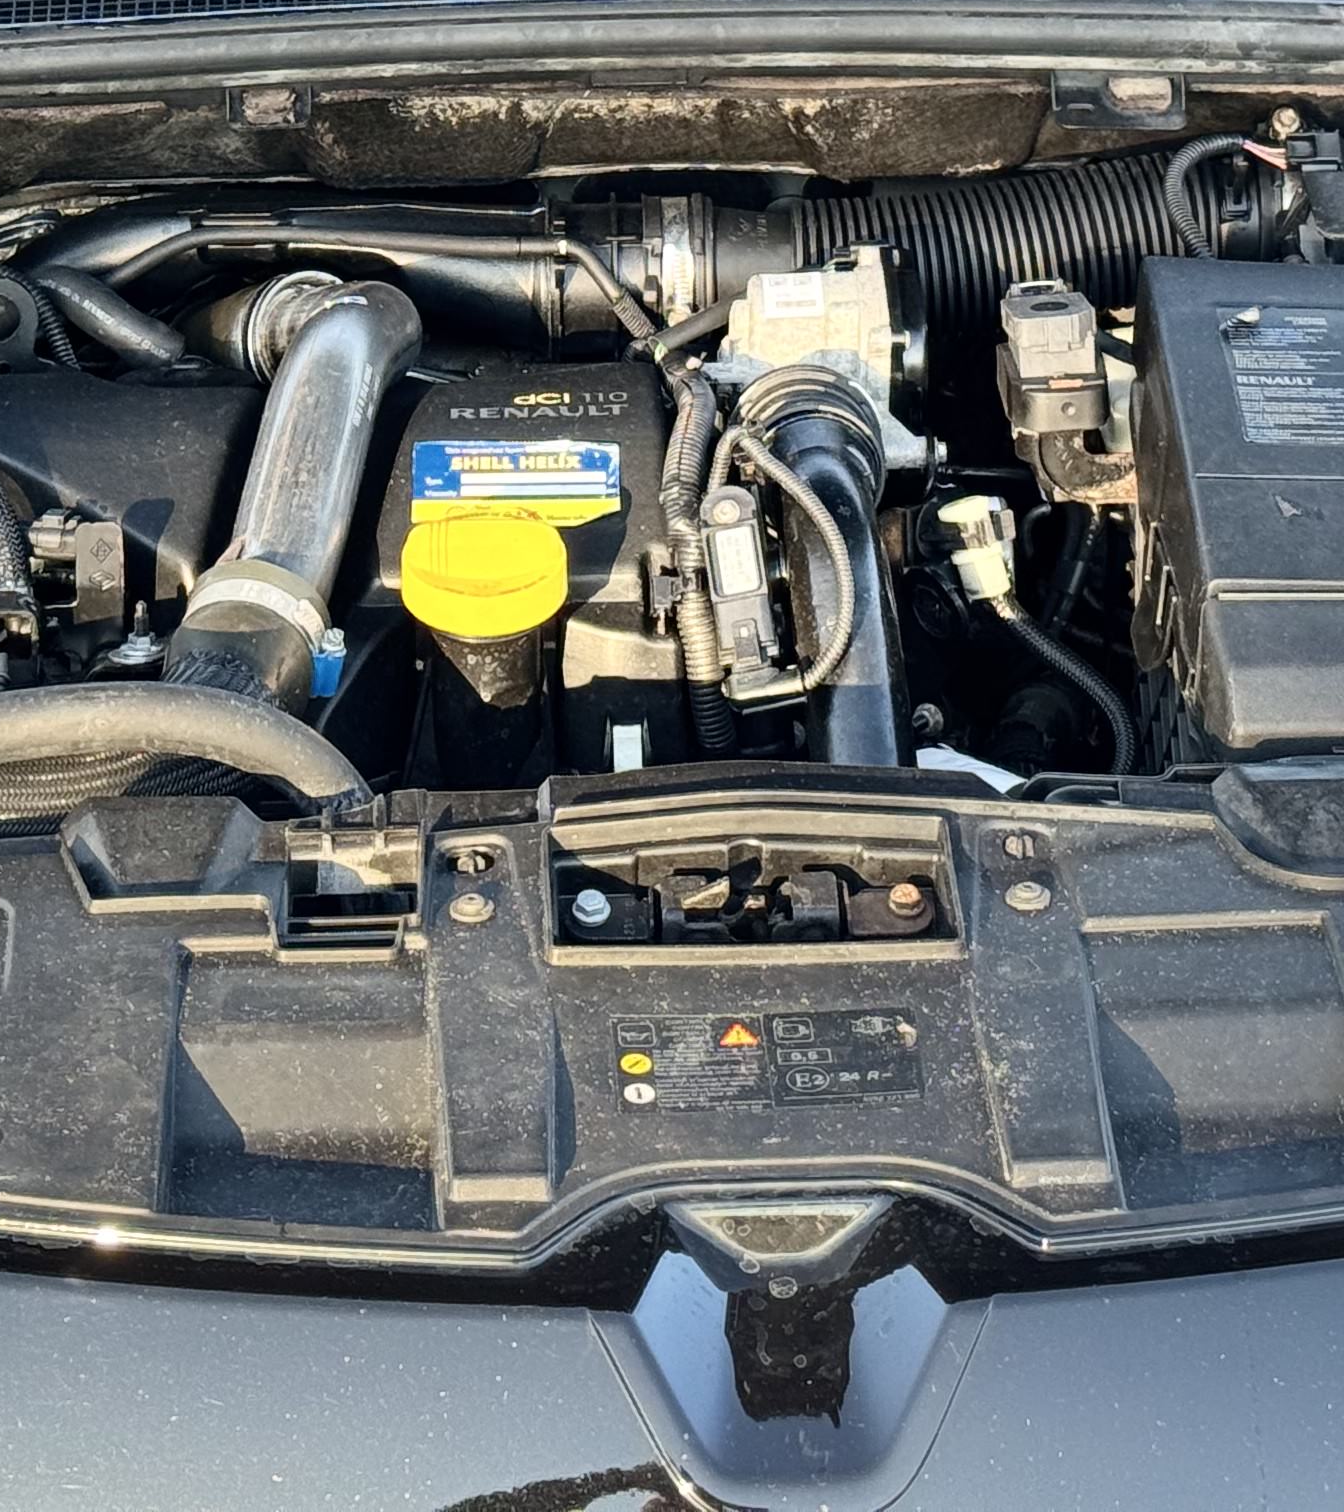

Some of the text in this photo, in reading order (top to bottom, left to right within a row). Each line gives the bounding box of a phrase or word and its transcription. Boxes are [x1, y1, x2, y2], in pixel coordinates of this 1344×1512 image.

[1236, 375, 1316, 386] RENAULT
[582, 391, 628, 403] 110
[449, 403, 630, 420] RENAULT
[450, 455, 514, 471] SHELL
[839, 1071, 861, 1082] 24
